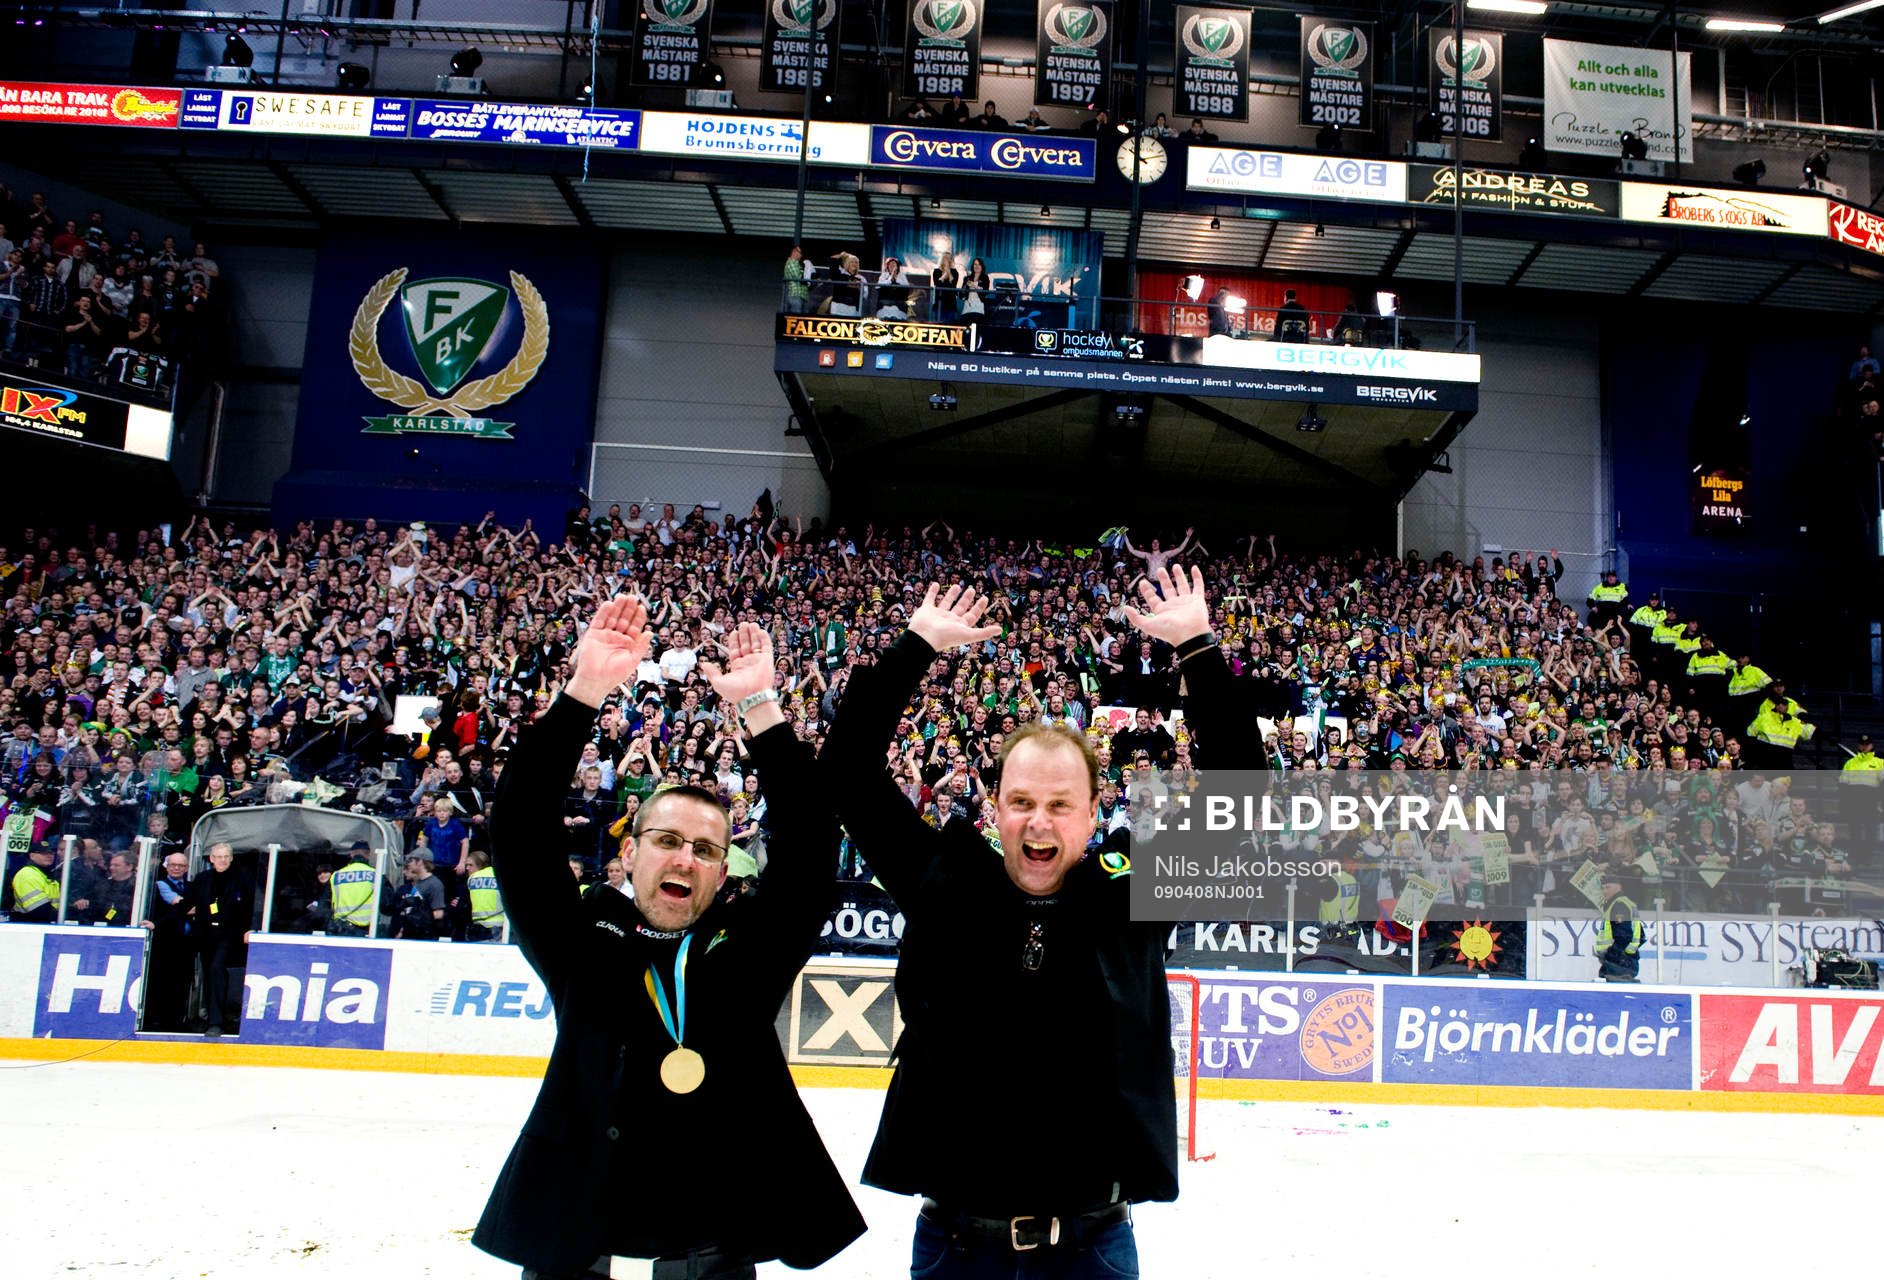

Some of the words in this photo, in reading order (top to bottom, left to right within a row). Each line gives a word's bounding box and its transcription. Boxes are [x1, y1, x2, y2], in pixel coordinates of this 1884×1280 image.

[643, 35, 699, 48] SVENSKA
[642, 46, 698, 62] MÄSTARE
[914, 49, 969, 63] SVENSKA
[648, 63, 690, 81] 1981
[913, 60, 969, 76] MÄSTARE
[1046, 57, 1101, 71] SVENSKA
[1577, 59, 1601, 74] Allt
[1605, 63, 1630, 77] och
[1633, 65, 1659, 79] alla
[1046, 68, 1101, 84] MÄSTARE
[1185, 67, 1238, 82] SVENSKA
[917, 77, 964, 94] 1988
[1051, 83, 1095, 102] 1997
[1184, 79, 1238, 96] MÄSTARE
[1311, 78, 1363, 92] SVENSKA
[1569, 78, 1596, 92] kan
[1600, 81, 1666, 98] utvecklas
[21, 89, 62, 104] BARA
[67, 92, 109, 107] TRAV.
[1189, 95, 1234, 114] 1998
[1310, 90, 1363, 106] MÄSTARE
[1439, 89, 1491, 104] SVNSKA
[79, 107, 108, 118] 2010!
[256, 96, 365, 118] SWESAFE
[471, 102, 583, 119] BÅTLEVERANTÖREN
[1312, 105, 1360, 124] 2002
[1439, 100, 1492, 117] MÄTARE
[417, 110, 488, 130] BOSSES
[492, 115, 634, 137] MARINSERVICE
[687, 117, 775, 137] HÖJDENS
[576, 135, 618, 145] ATLANTICA
[883, 131, 977, 162] Cervera
[990, 138, 1083, 169] Cervera
[1208, 151, 1282, 178] AGE
[1313, 159, 1387, 187] AGE
[1438, 171, 1589, 197] ANDREAS
[1472, 192, 1531, 205] FASHION
[1535, 198, 1545, 207] &
[785, 319, 855, 338] FALCON
[892, 325, 964, 345] SOFFAN
[1062, 331, 1111, 349] hockey
[1062, 346, 1123, 358] ombudsmannen
[1276, 348, 1409, 371] BERGVIK
[928, 361, 957, 372] Nära
[961, 363, 978, 372] 60
[982, 364, 1022, 375] butiker
[1026, 367, 1040, 378] på
[1044, 369, 1084, 378] samma
[1087, 370, 1119, 381] plats.
[1122, 371, 1157, 384] Öppet
[1161, 375, 1199, 385] nästan
[1202, 376, 1232, 388] jämt!
[1236, 380, 1324, 393] www.bergvik.se
[1356, 385, 1438, 403] BERGVIK
[57, 407, 87, 424] FM
[32, 421, 83, 438] KARLSTAD
[393, 417, 485, 432] KARLSTAD
[1701, 475, 1743, 492] Löfbergs
[1713, 490, 1732, 502] Lila
[1702, 505, 1743, 518] ARENA
[337, 871, 374, 883] POLIS
[470, 876, 497, 889] POLIS
[1487, 871, 1507, 884] 2009
[640, 929, 688, 940] ODDSET
[1305, 1004, 1333, 1049] GRYTS
[1729, 1003, 1884, 1086] AV
